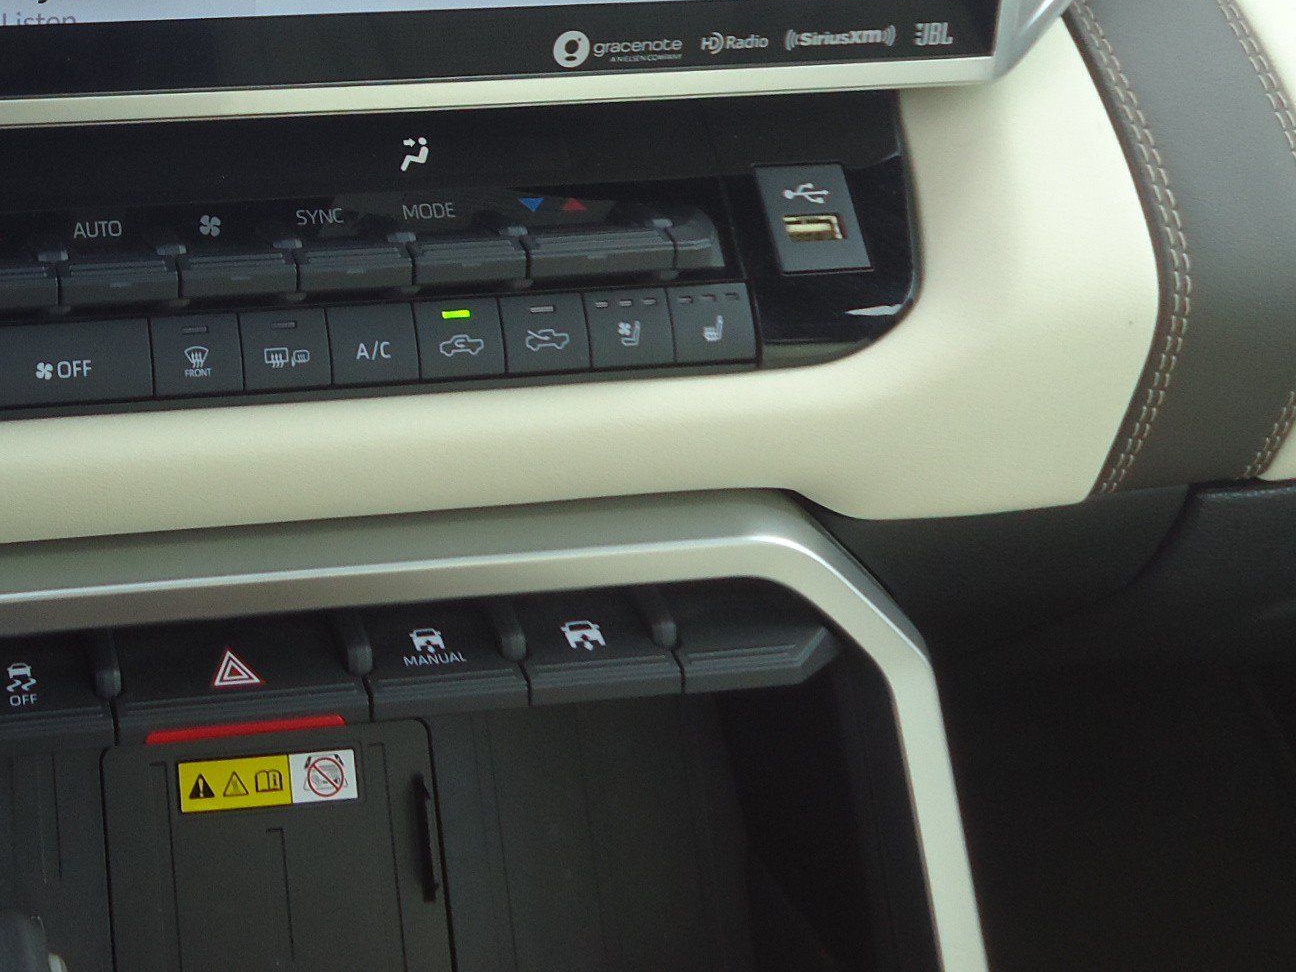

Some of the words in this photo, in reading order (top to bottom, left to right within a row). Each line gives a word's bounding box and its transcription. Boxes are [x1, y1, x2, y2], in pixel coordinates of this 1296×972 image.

[726, 34, 769, 50] Radio
[914, 22, 954, 45] JBL
[593, 38, 683, 57] gracenote
[296, 208, 345, 227] SYNC
[402, 202, 456, 222] MODE
[73, 220, 123, 239] AUTO
[356, 340, 391, 362] A/C
[57, 359, 92, 380] OFF
[183, 368, 212, 378] FRONT
[404, 652, 466, 666] MANUAL
[9, 694, 37, 706] OFF
